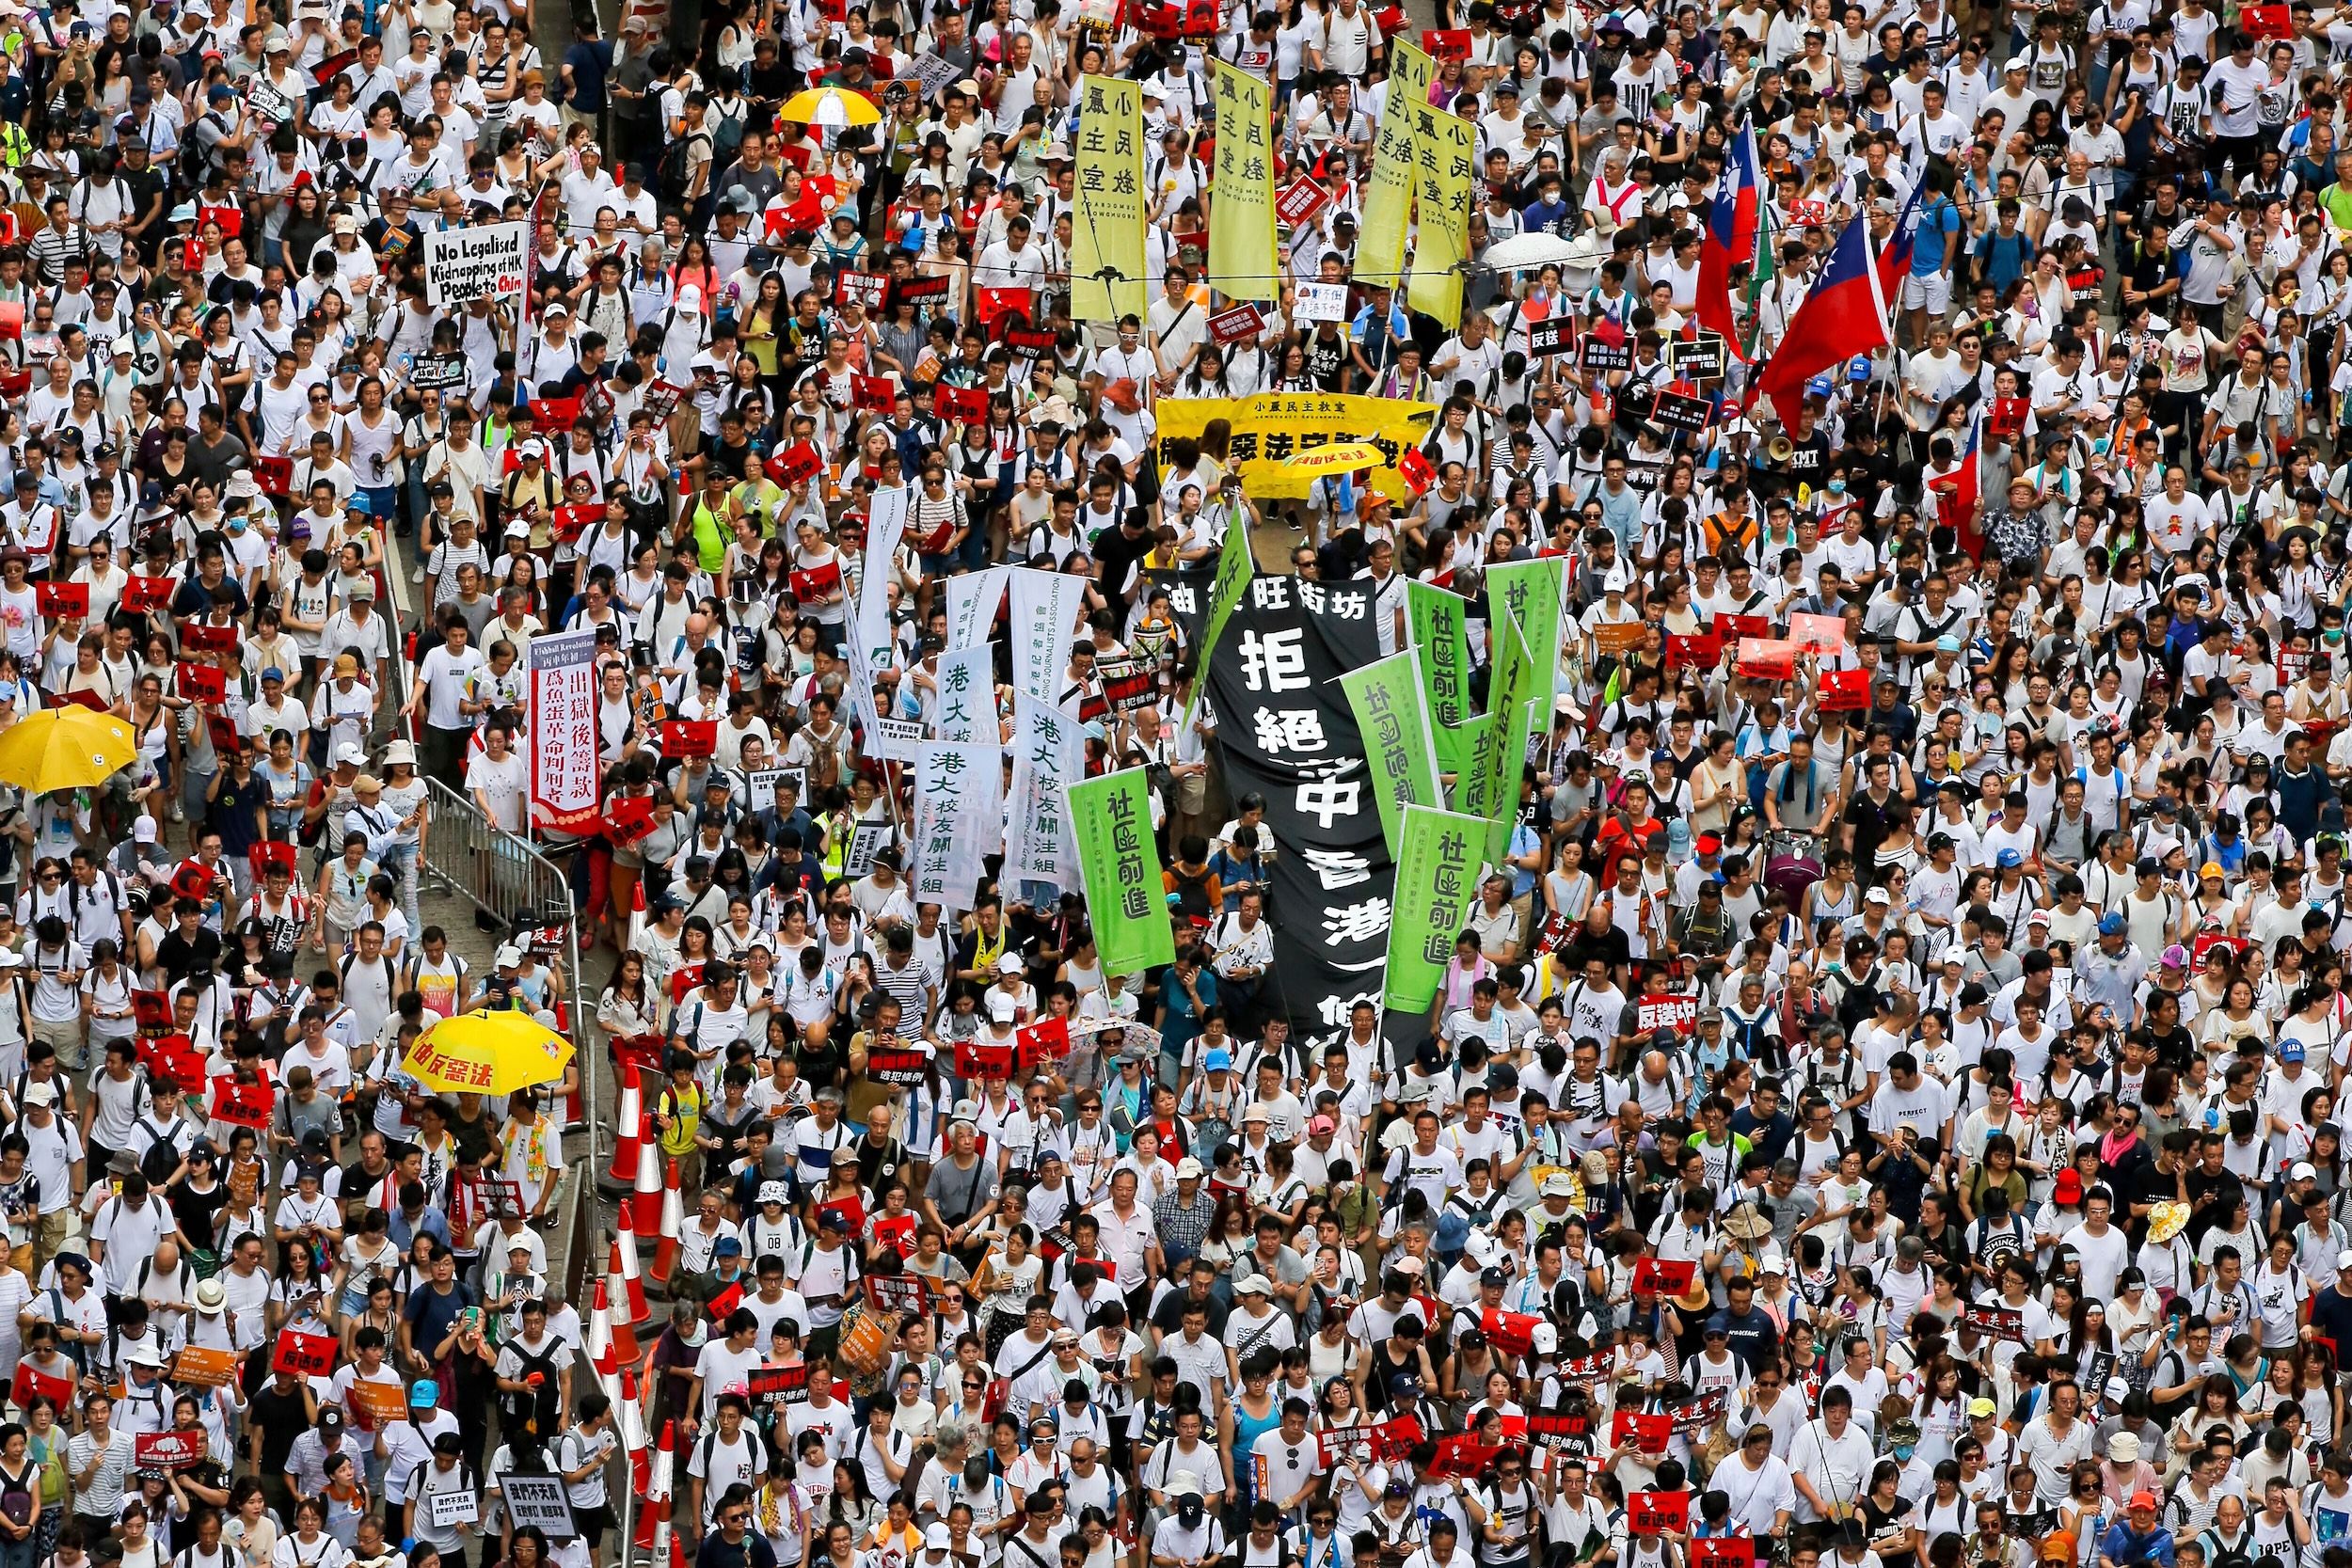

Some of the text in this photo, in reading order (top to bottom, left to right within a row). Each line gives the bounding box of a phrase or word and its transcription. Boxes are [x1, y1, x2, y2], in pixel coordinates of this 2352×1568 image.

[2172, 102, 2200, 118] NEW
[436, 238, 519, 265] No Legalised
[430, 256, 523, 287] Kidnapping of HK
[440, 280, 482, 303] People
[482, 277, 497, 293] to
[1161, 574, 1367, 622] 油旺街坊
[561, 639, 596, 653] Revolution
[1431, 605, 1462, 730] 社區前進
[568, 672, 593, 800] 出獄後籌款
[1107, 788, 1152, 920] 社區前進
[1422, 830, 1468, 967] 社區前進
[532, 925, 564, 946] 反送
[1638, 1001, 1697, 1029] 反送中
[1898, 1107, 1928, 1117] PERFECT
[768, 1237, 781, 1249] 08
[1642, 1275, 1684, 1291] 反送中
[1965, 1308, 2022, 1333] 反送中
[282, 1351, 326, 1369] 反送中
[1557, 1351, 1615, 1377] 反送中
[1701, 1374, 1734, 1386] TATTOO YOU
[1668, 1394, 1723, 1422] 反送中
[508, 1481, 561, 1502] 我們不天真
[1637, 1512, 1680, 1528] 反送中
